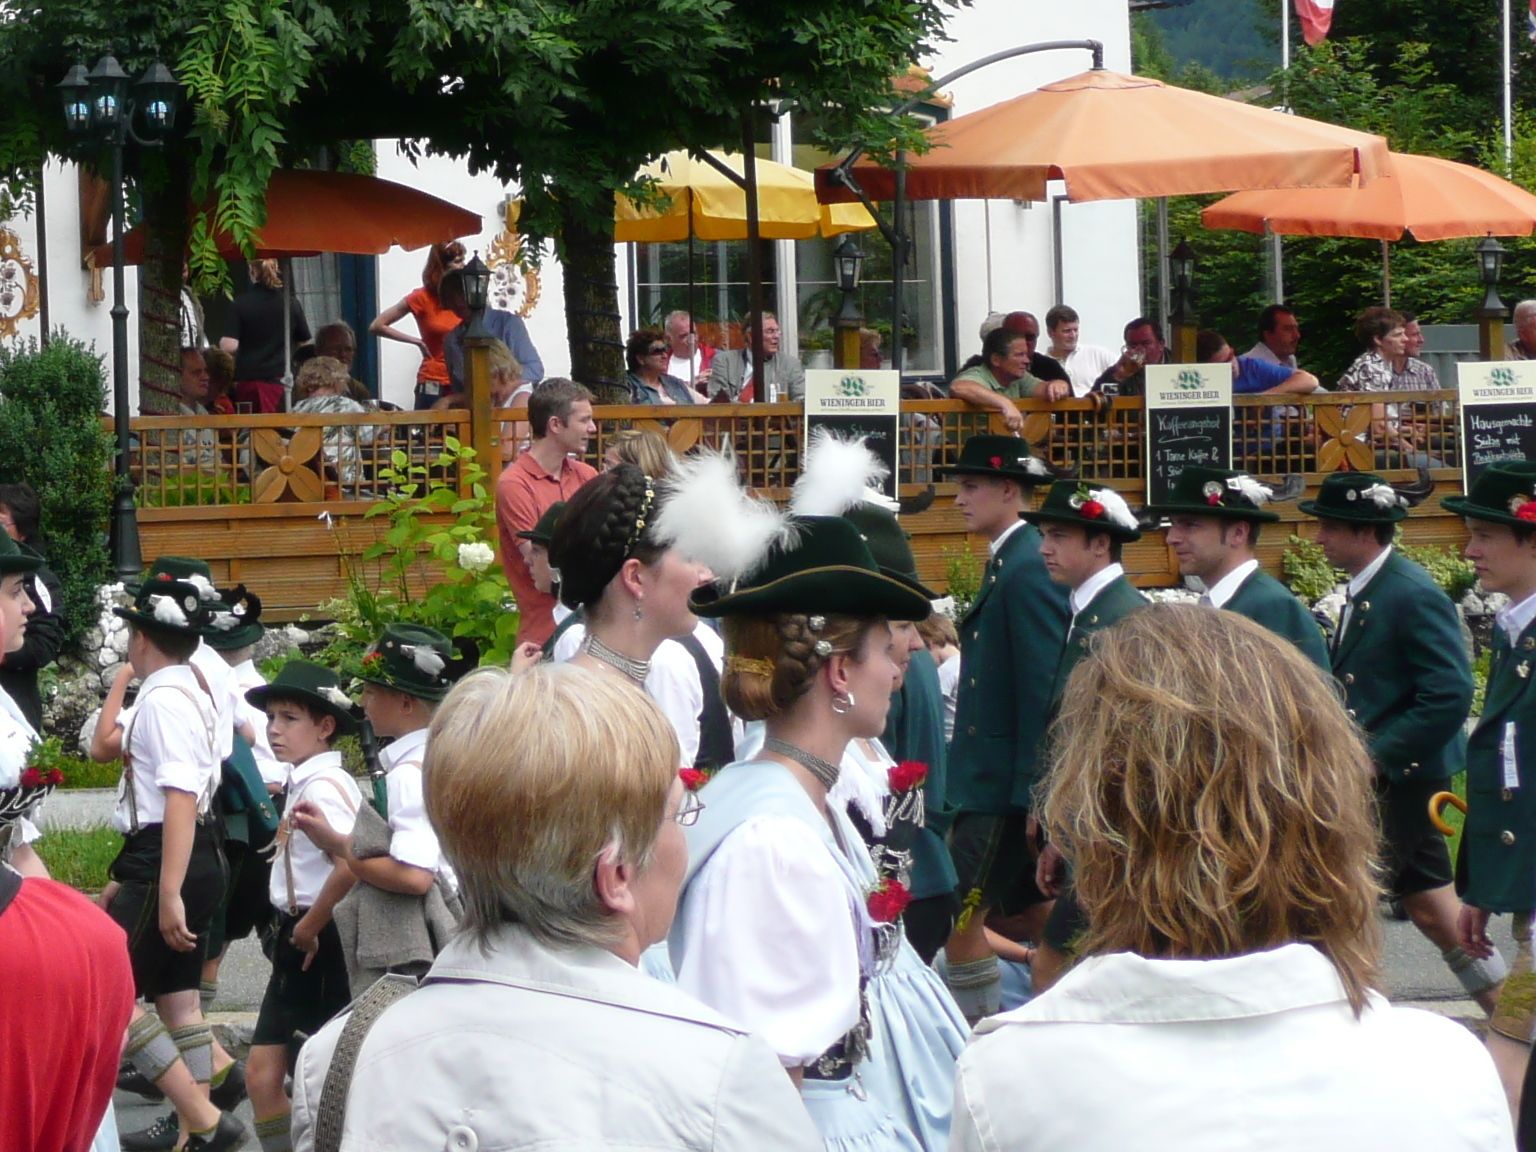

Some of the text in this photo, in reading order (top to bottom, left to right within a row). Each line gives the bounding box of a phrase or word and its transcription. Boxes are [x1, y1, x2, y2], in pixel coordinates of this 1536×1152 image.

[1160, 391, 1220, 400] WIENINGER BIER
[1473, 388, 1515, 397] WIENINGER
[820, 399, 885, 407] WIENINGER BIER
